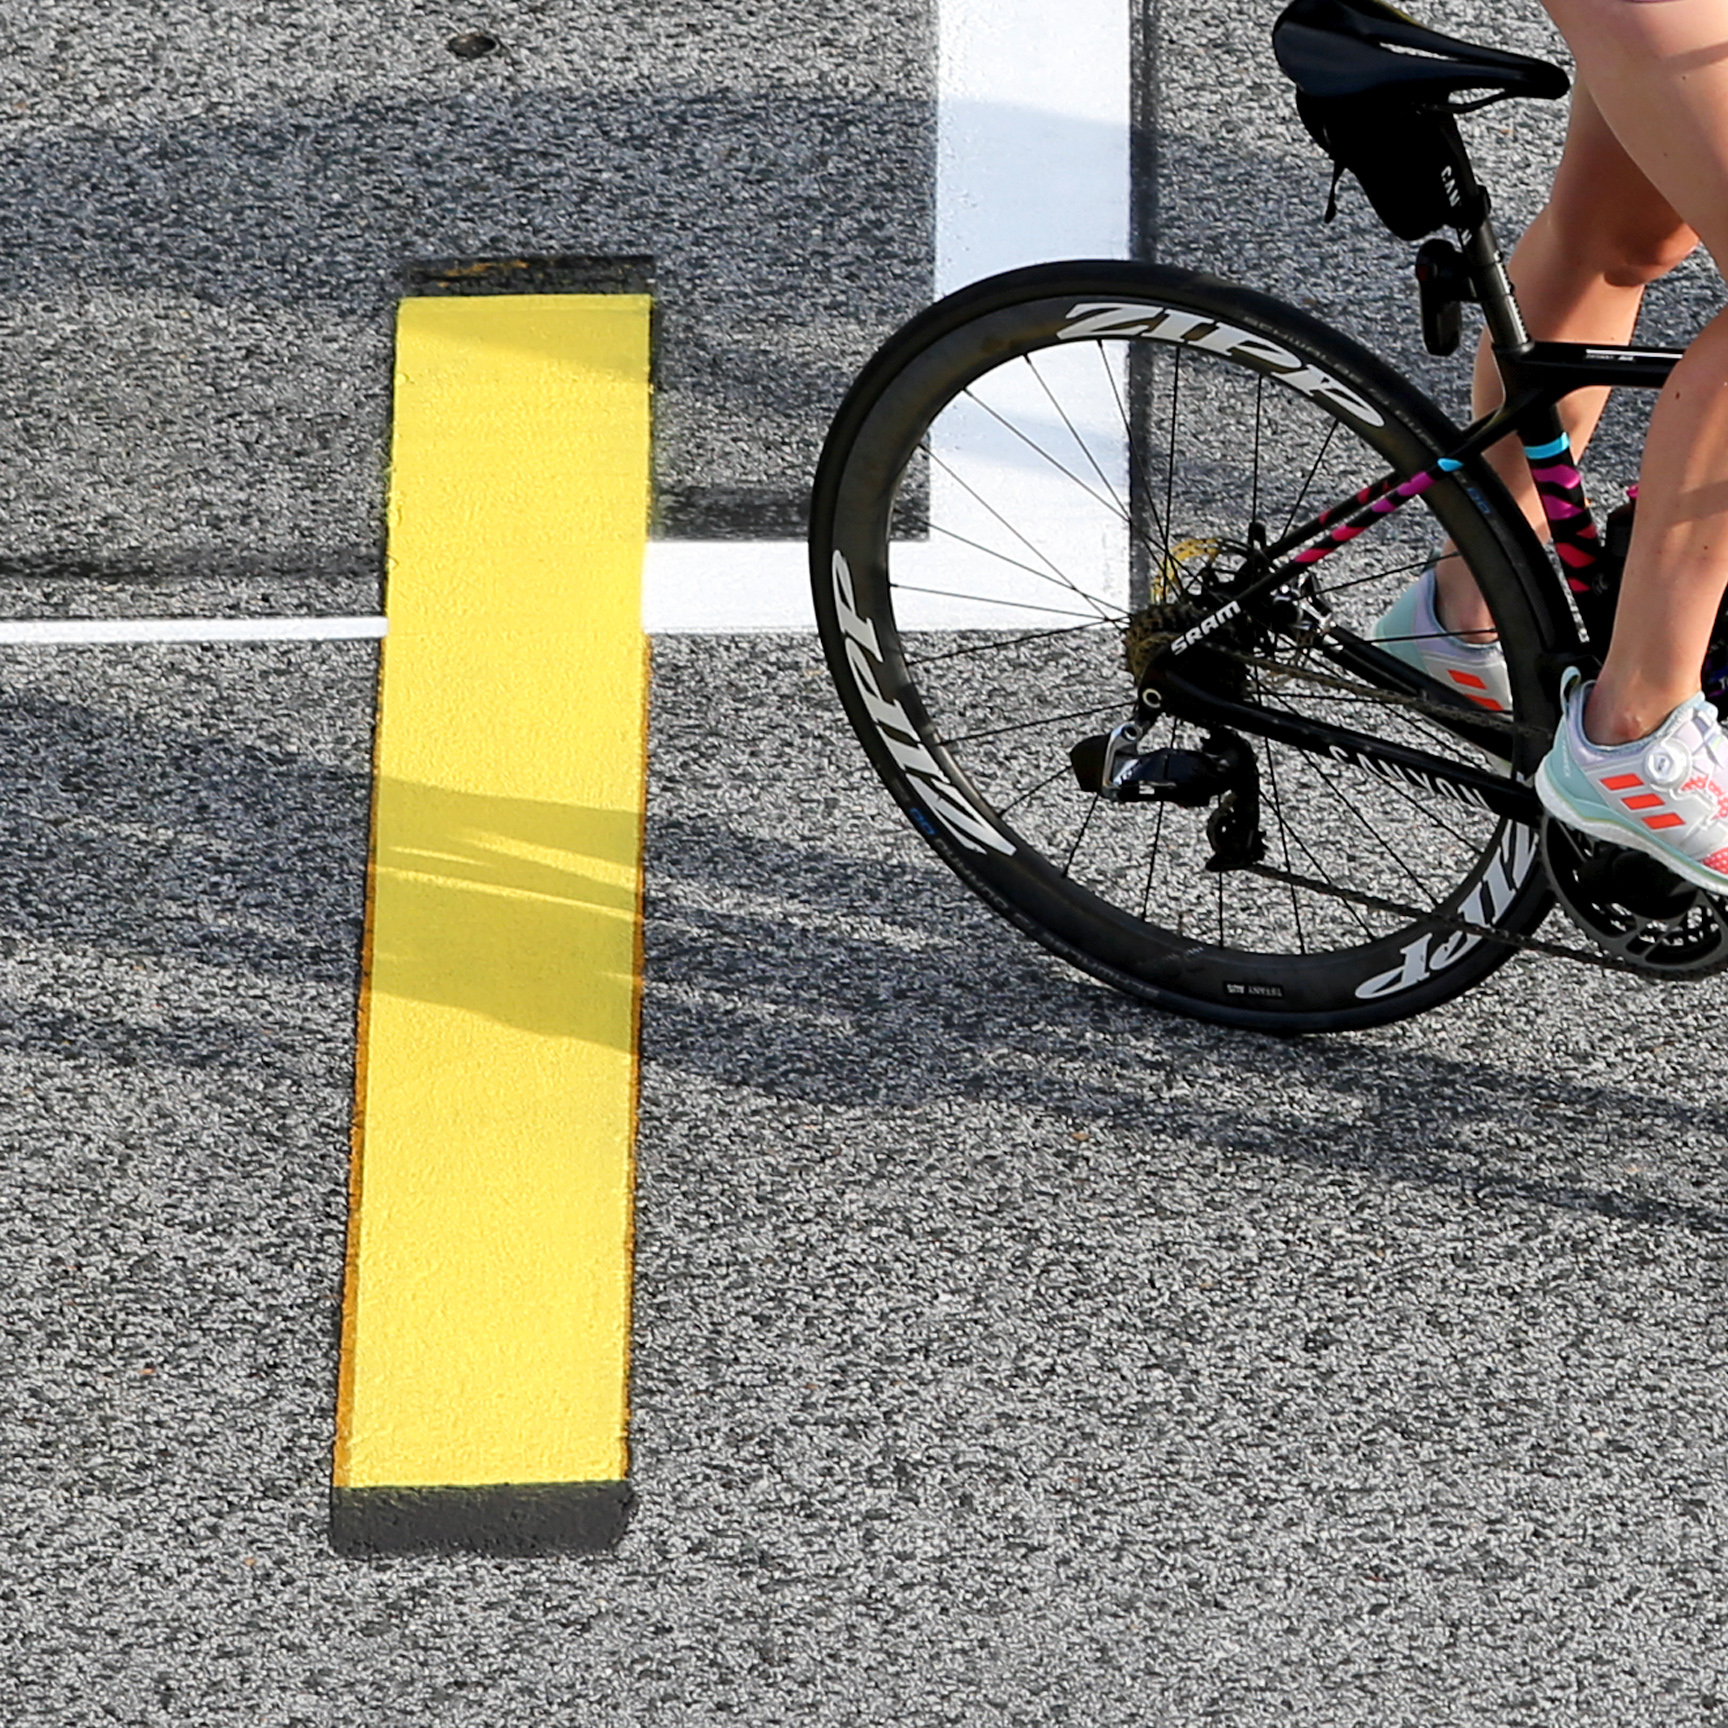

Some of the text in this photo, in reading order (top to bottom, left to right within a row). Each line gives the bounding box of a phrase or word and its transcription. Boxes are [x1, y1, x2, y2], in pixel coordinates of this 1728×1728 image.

[1441, 165, 1473, 246] CANN
[1056, 302, 1386, 428] ZIPP
[1170, 600, 1242, 655] SRAM
[832, 549, 1017, 857] ZIPP
[1331, 743, 1484, 808] CANYON
[1354, 818, 1540, 999] ZIPP
